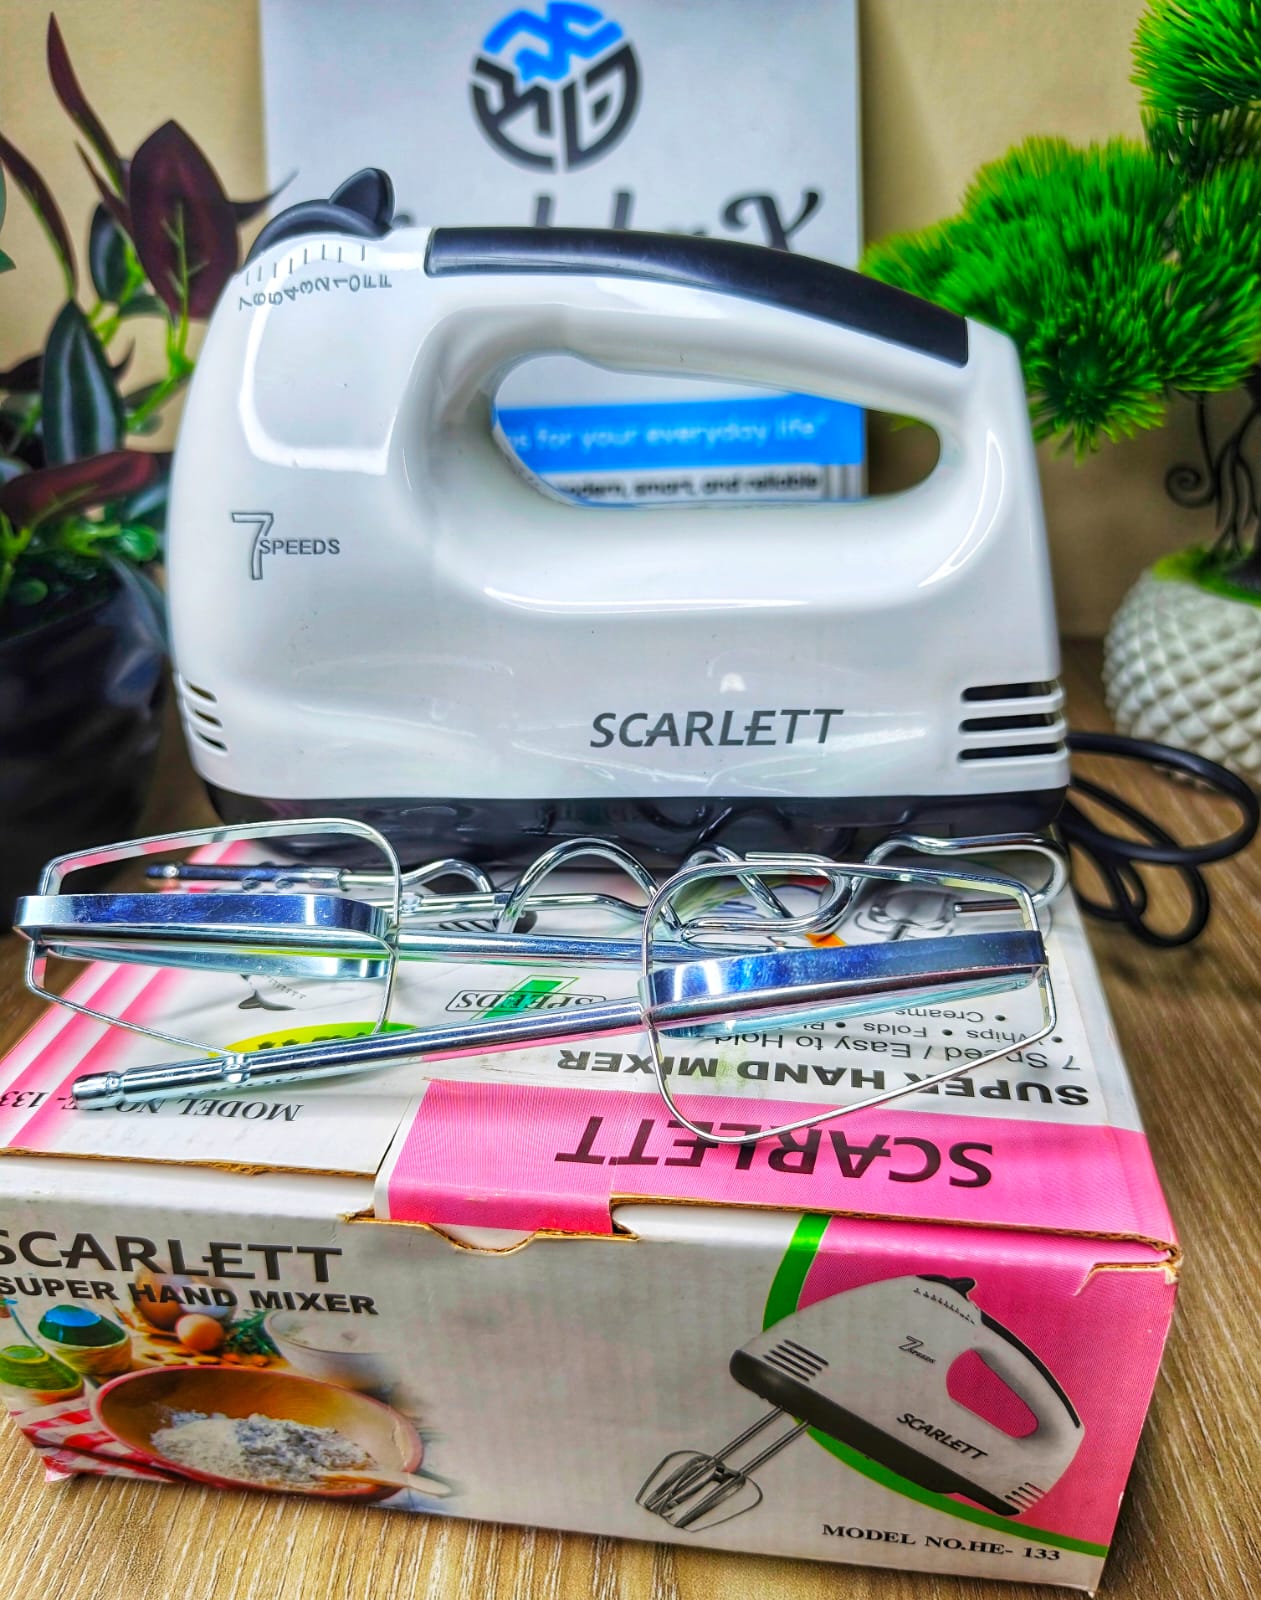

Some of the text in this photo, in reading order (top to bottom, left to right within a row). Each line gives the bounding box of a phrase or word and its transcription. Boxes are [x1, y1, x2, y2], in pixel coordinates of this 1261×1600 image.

[349, 274, 393, 293] OFF
[259, 538, 341, 555] SPEEDS
[590, 708, 844, 748] SCARLETT
[796, 1035, 823, 1051] to
[863, 1022, 928, 1038] Folds
[835, 1036, 911, 1059] Easy
[1062, 1055, 1081, 1070] 7
[557, 1049, 1090, 1106] SUPER HAND MIXER
[177, 1096, 304, 1122] MODEL
[555, 1115, 994, 1188] SCARLETT
[0, 1276, 380, 1316] SUPER HAND MIXER
[896, 1412, 988, 1460] SCARLETT
[822, 1523, 916, 1546] MODEL
[1023, 1546, 1061, 1561] 133
